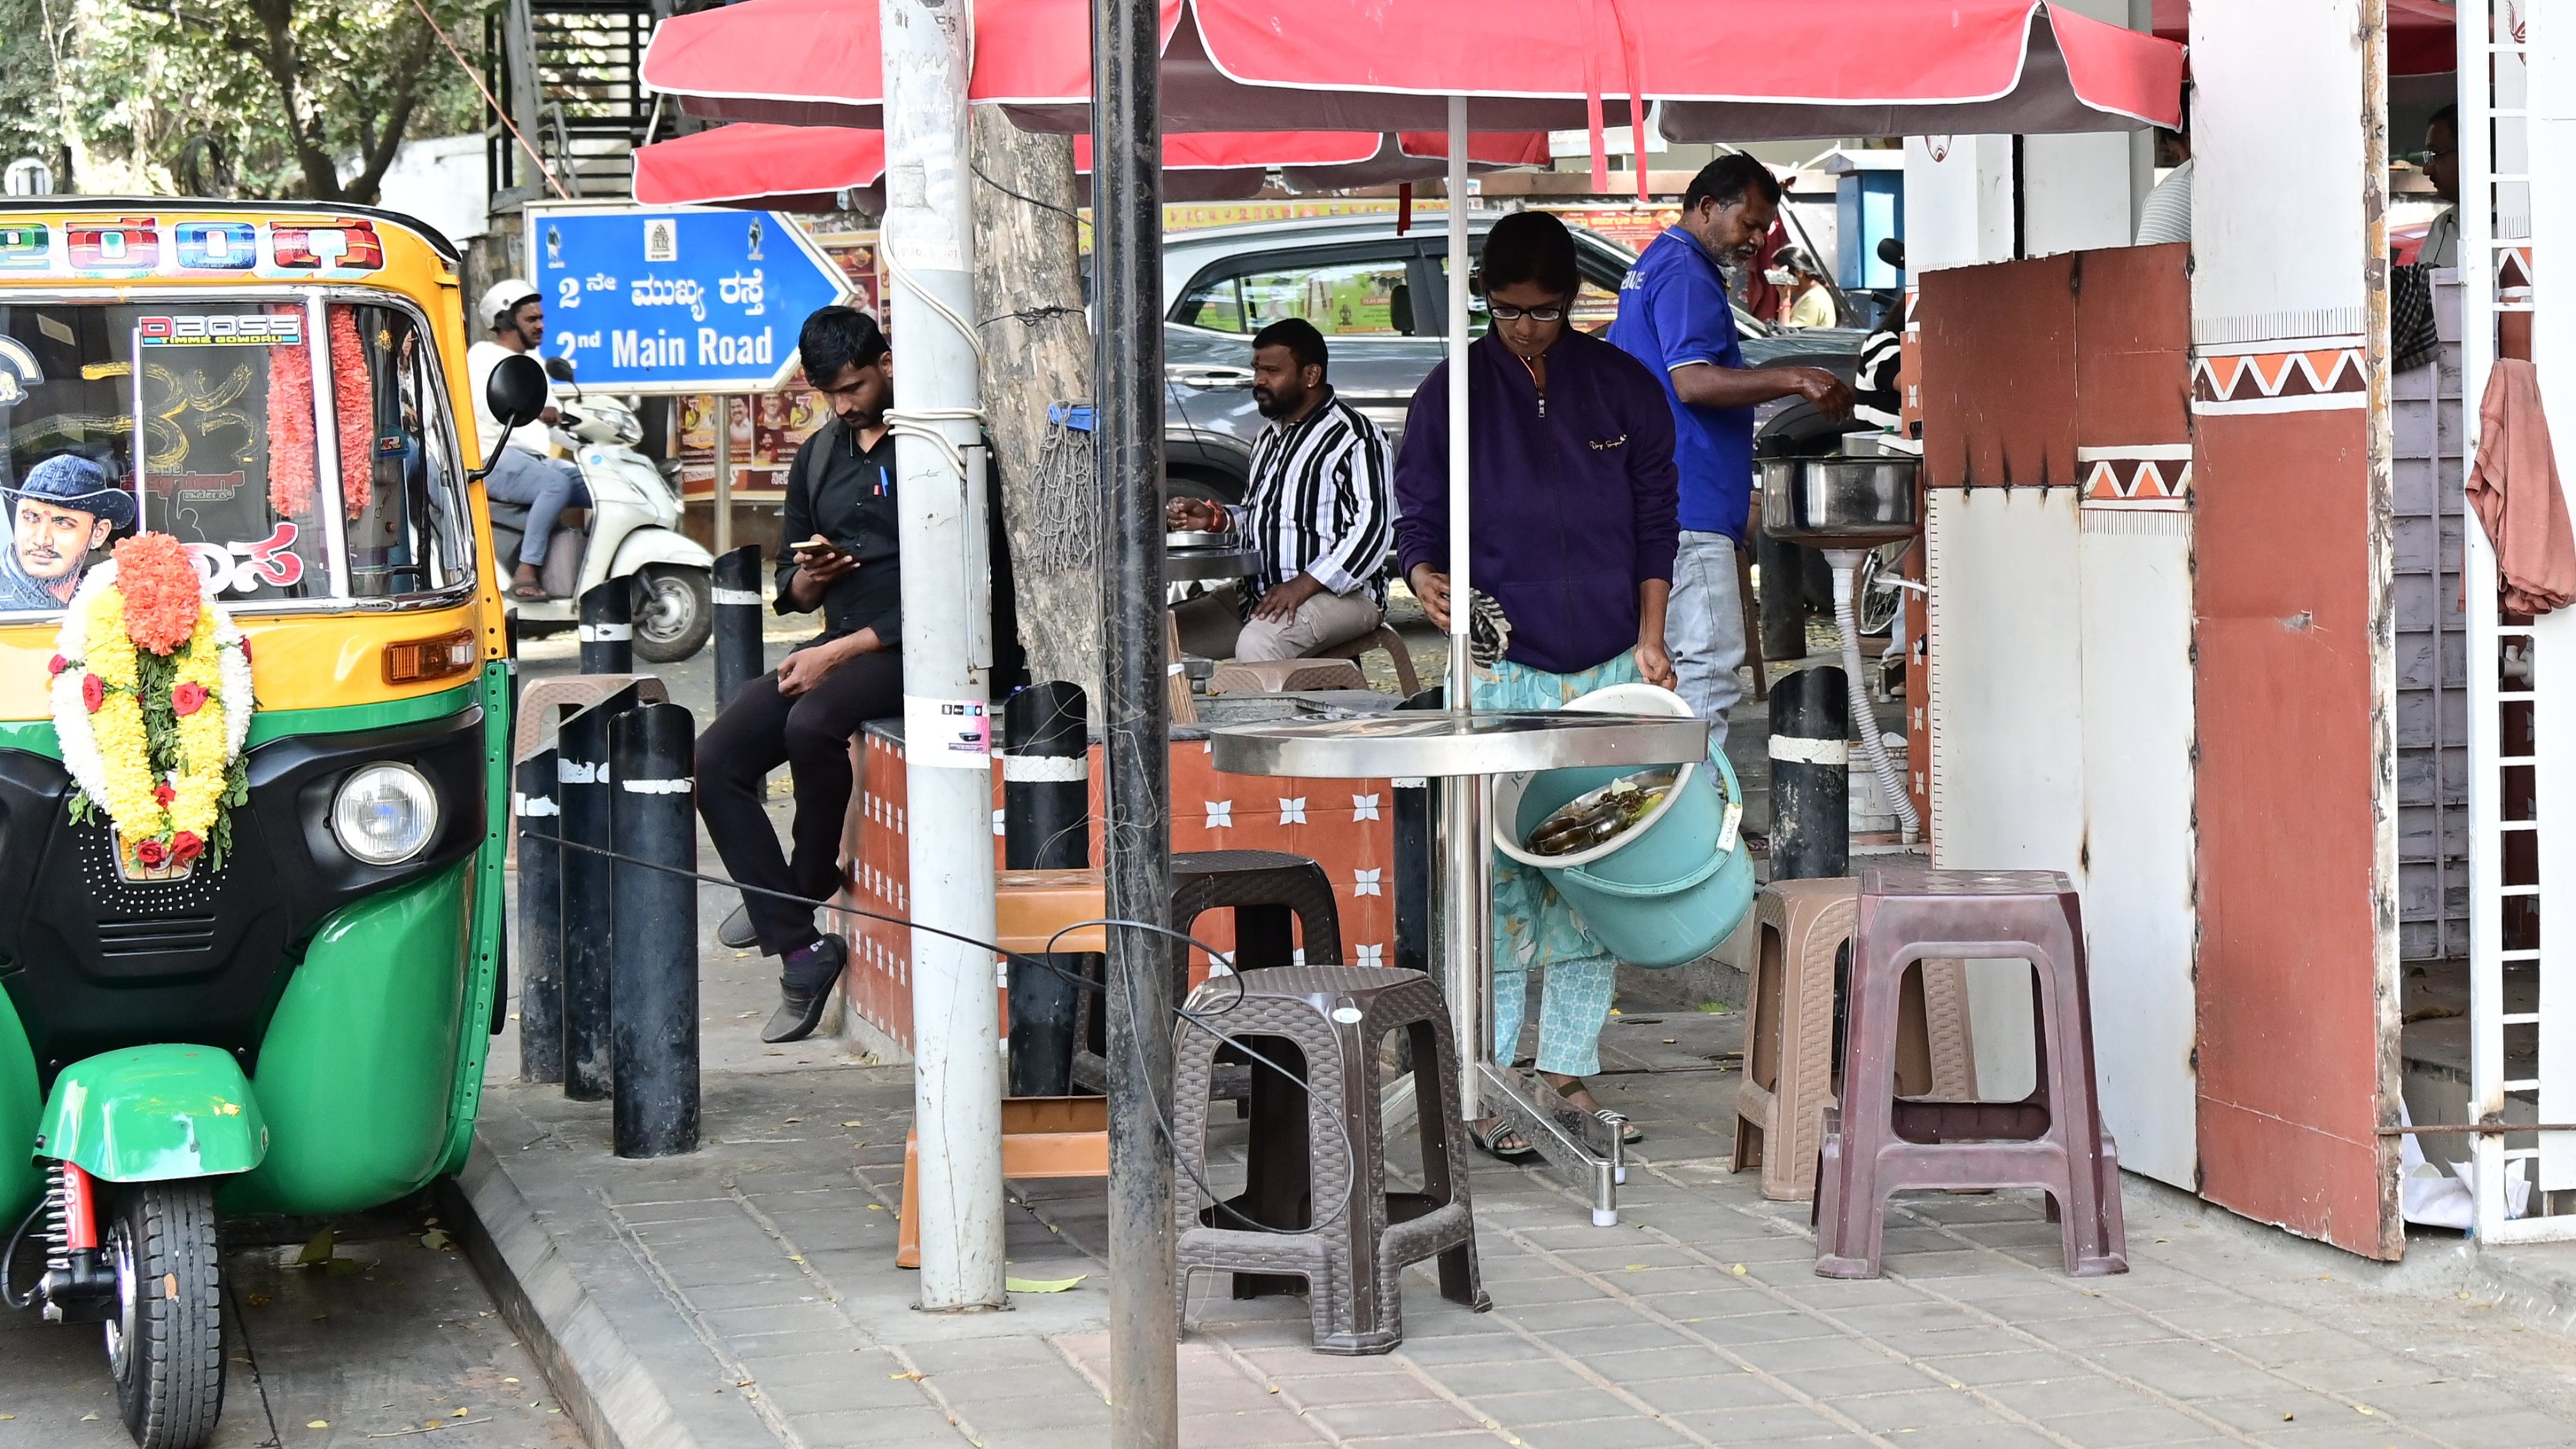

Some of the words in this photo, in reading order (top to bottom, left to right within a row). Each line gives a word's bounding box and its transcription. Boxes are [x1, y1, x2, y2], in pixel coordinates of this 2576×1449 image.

[631, 271, 706, 321] ಮುಖ್ಯ
[718, 268, 765, 315] ರಸ್ತೆ
[556, 331, 602, 369] 2nd
[612, 329, 686, 368] Main
[698, 326, 772, 365] Road
